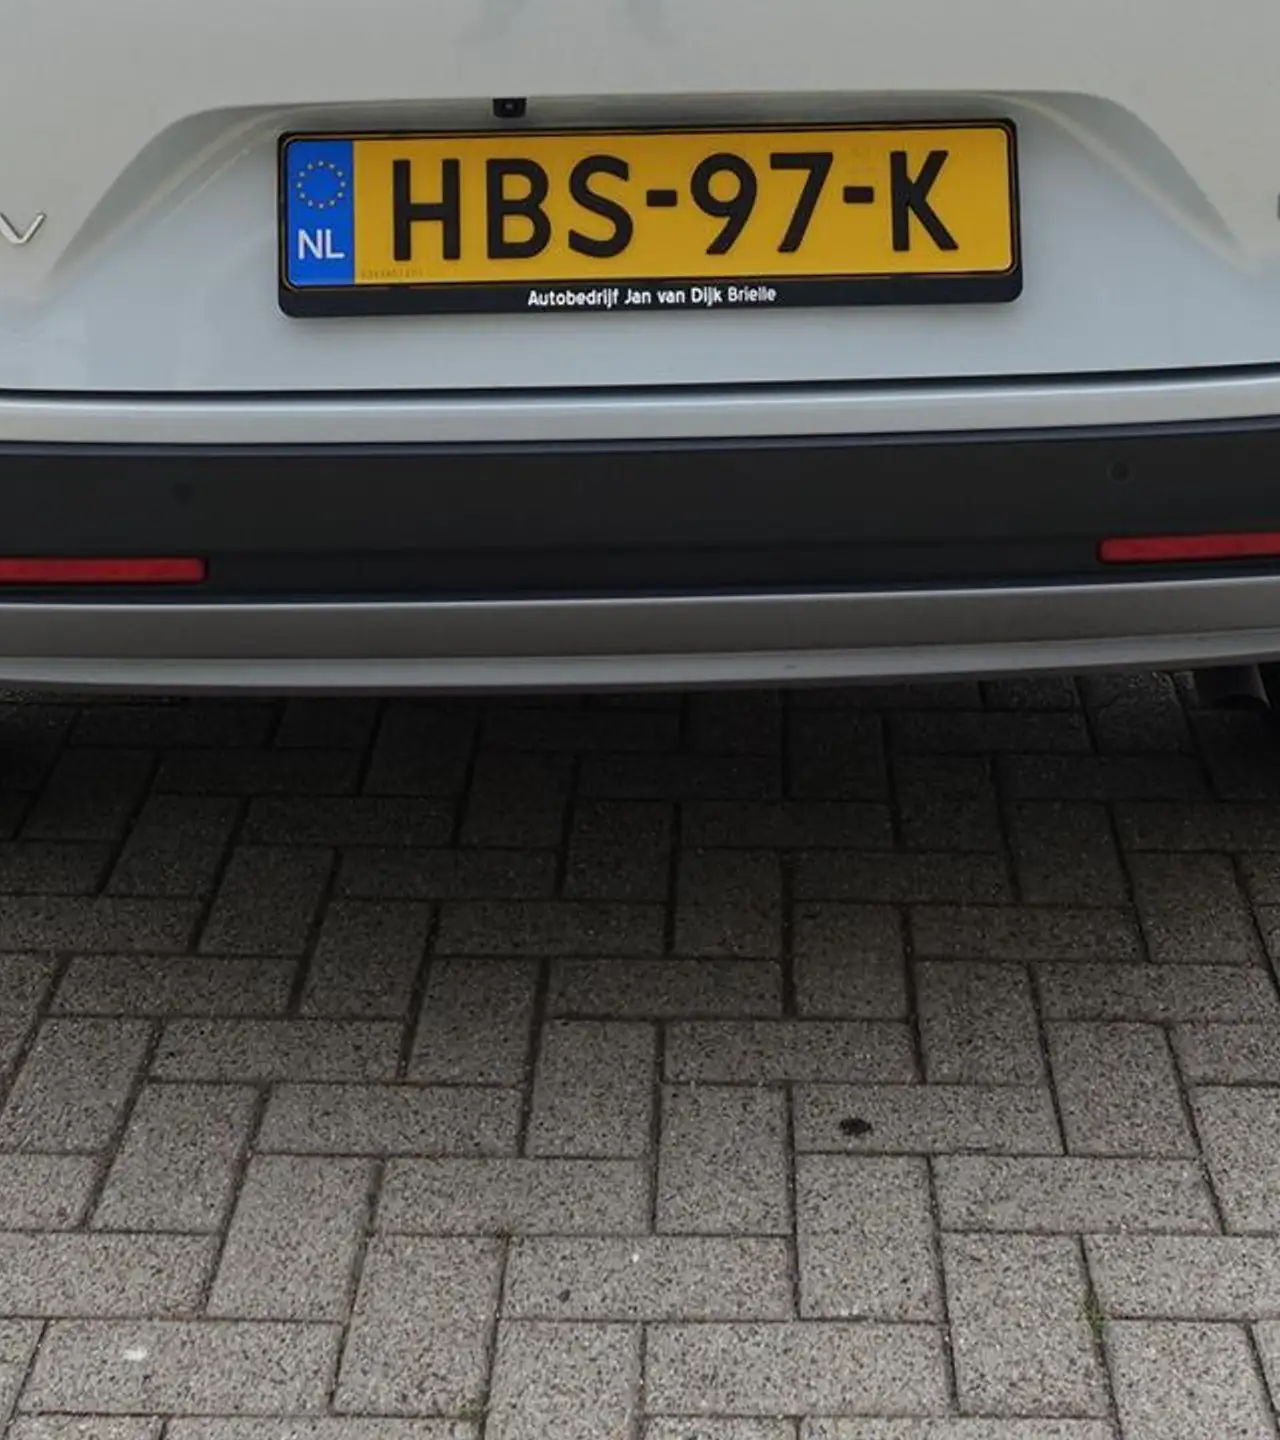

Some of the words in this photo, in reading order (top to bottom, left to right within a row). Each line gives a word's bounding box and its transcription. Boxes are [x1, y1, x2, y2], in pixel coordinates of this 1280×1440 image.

[392, 150, 958, 261] HBS-97-K
[298, 230, 344, 260] NL
[528, 288, 619, 309] Autobedrijf
[624, 288, 651, 305] Jan
[657, 290, 685, 304] van
[691, 286, 722, 307] Dijk
[728, 285, 776, 302] Brielle
